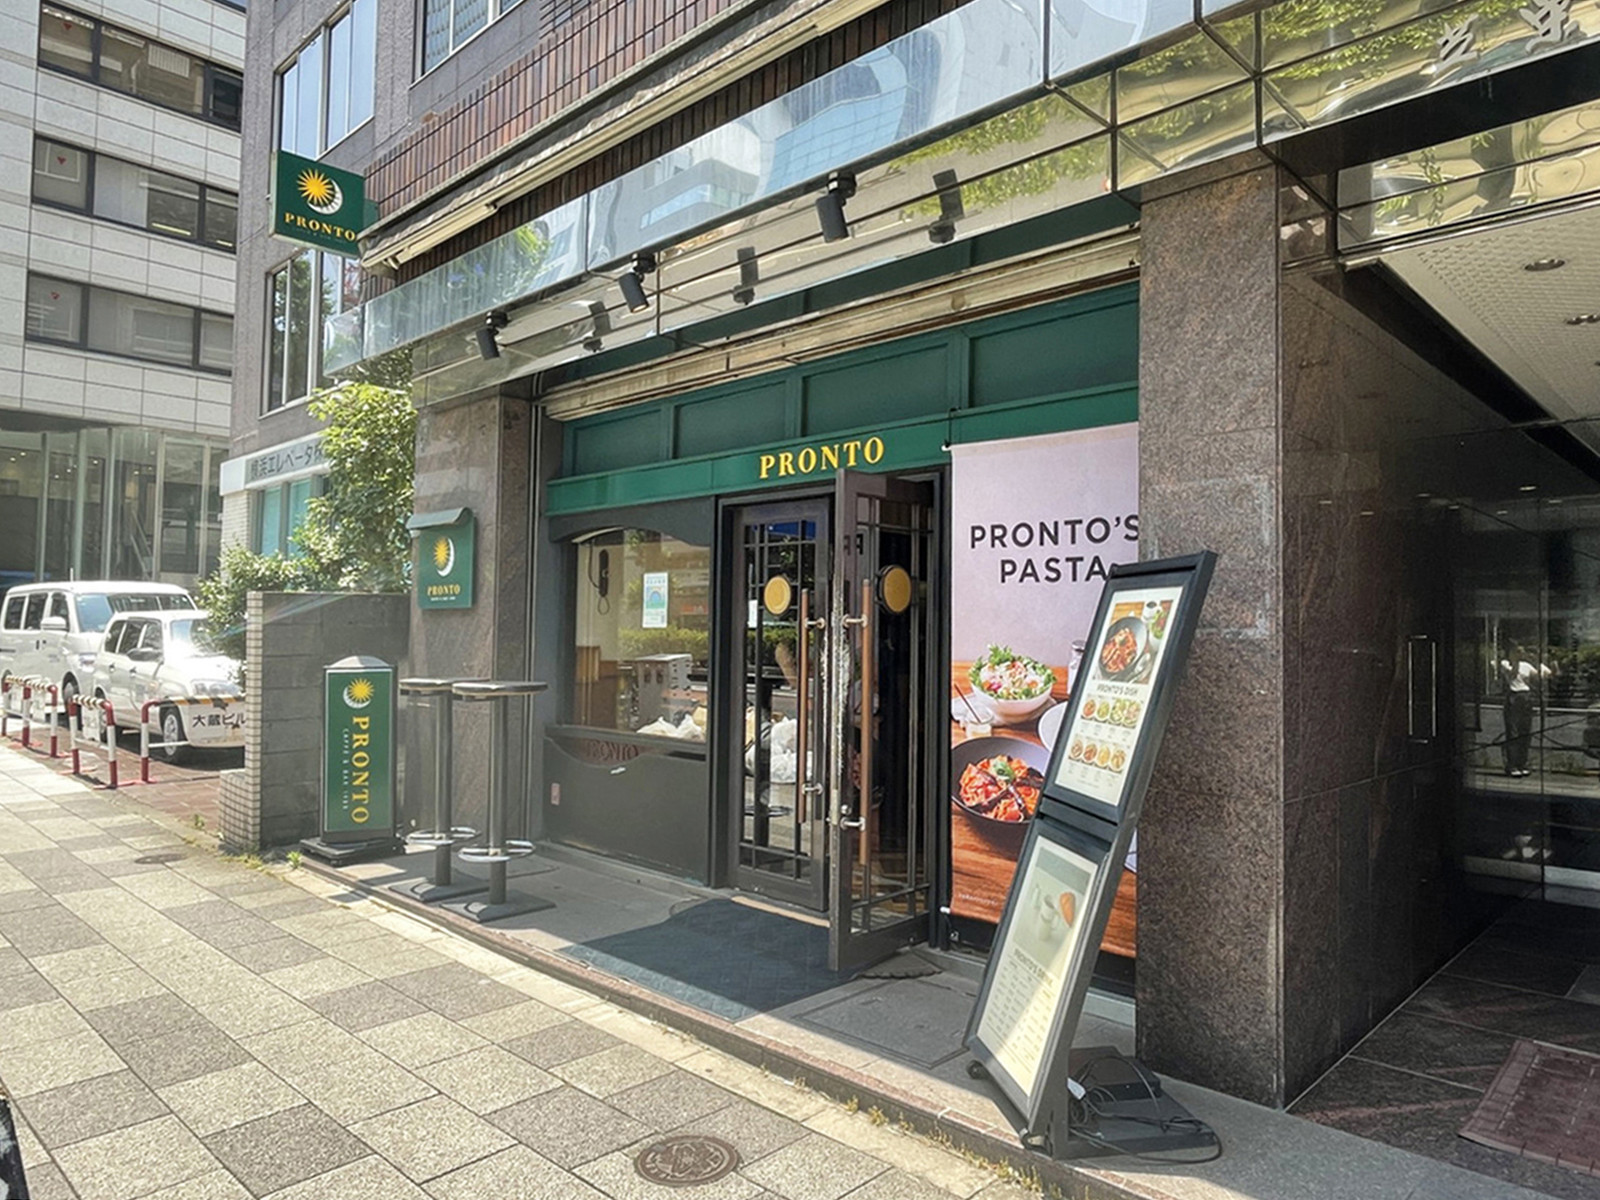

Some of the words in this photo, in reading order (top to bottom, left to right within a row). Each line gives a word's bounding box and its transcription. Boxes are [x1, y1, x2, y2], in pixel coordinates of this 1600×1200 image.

[284, 212, 356, 241] PRONTO
[760, 436, 884, 479] PRONTO
[970, 514, 1139, 549] PRONTO'S
[1000, 555, 1108, 583] PASTA
[427, 583, 461, 596] PRONTO
[352, 716, 370, 824] PRONTO
